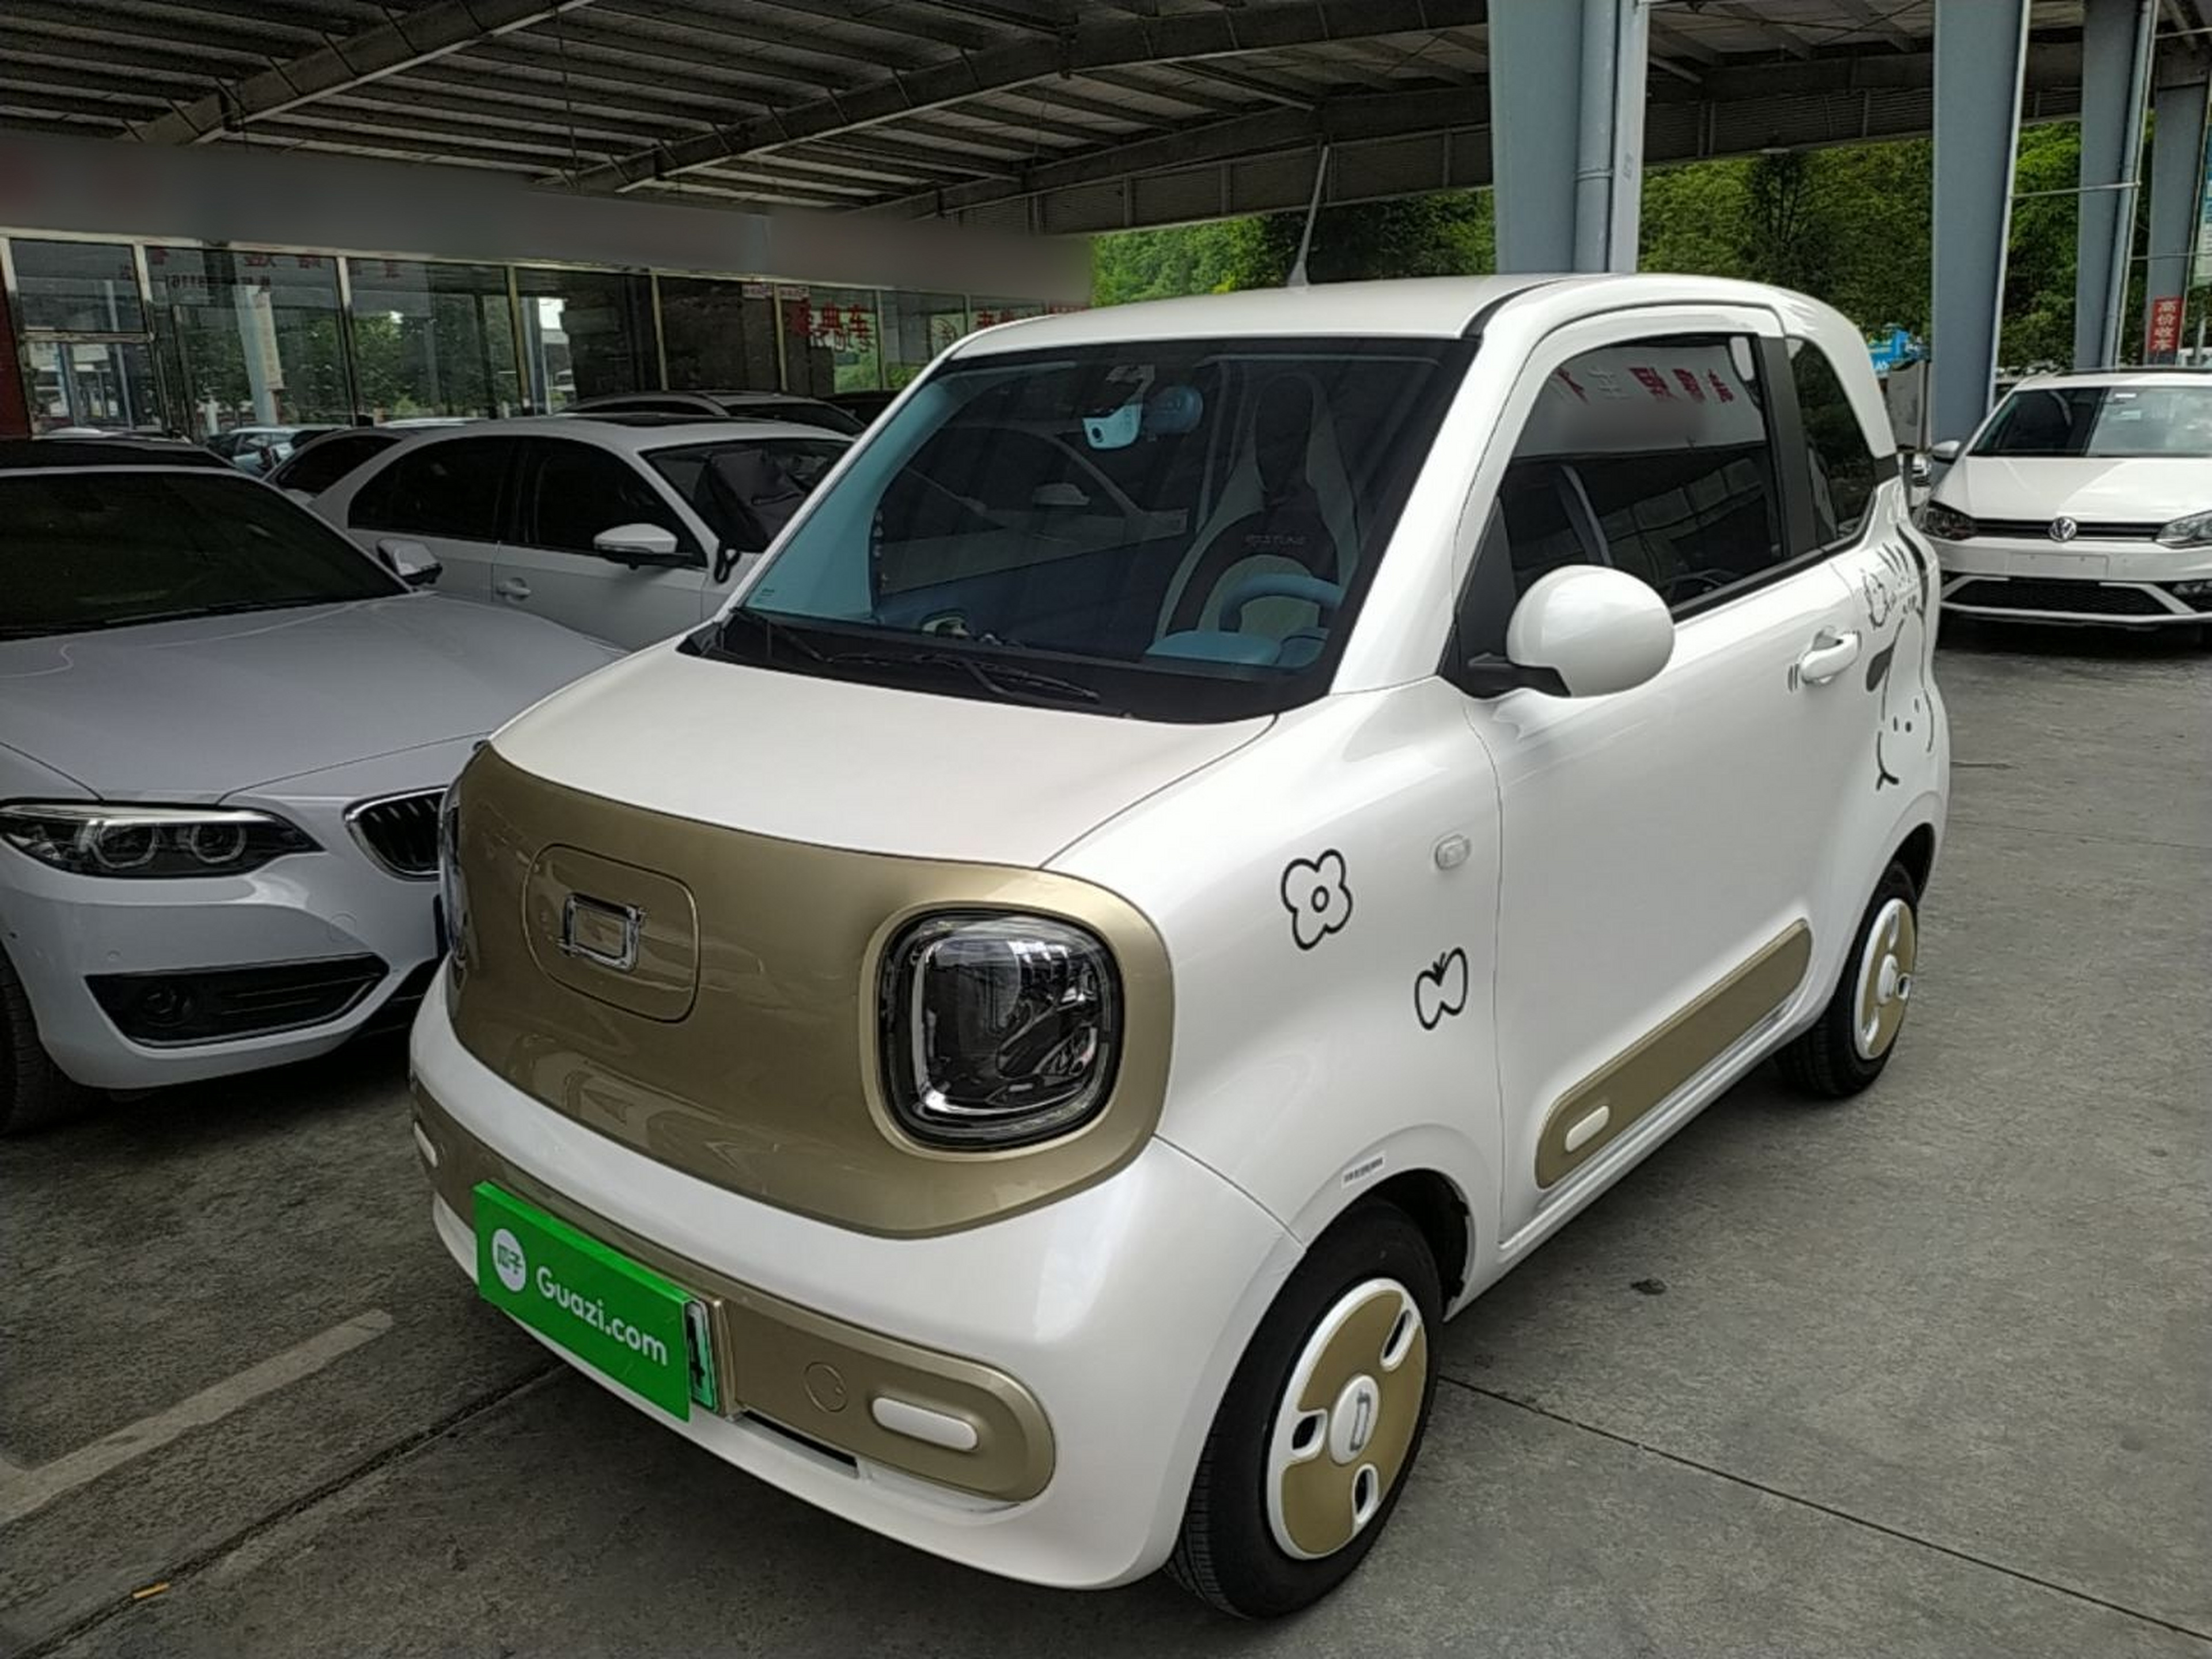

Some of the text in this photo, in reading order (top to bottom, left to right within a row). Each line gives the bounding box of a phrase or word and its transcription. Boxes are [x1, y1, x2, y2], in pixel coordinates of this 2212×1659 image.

[2153, 301, 2176, 351] 高价收车
[536, 1266, 668, 1366] Guazi.com
